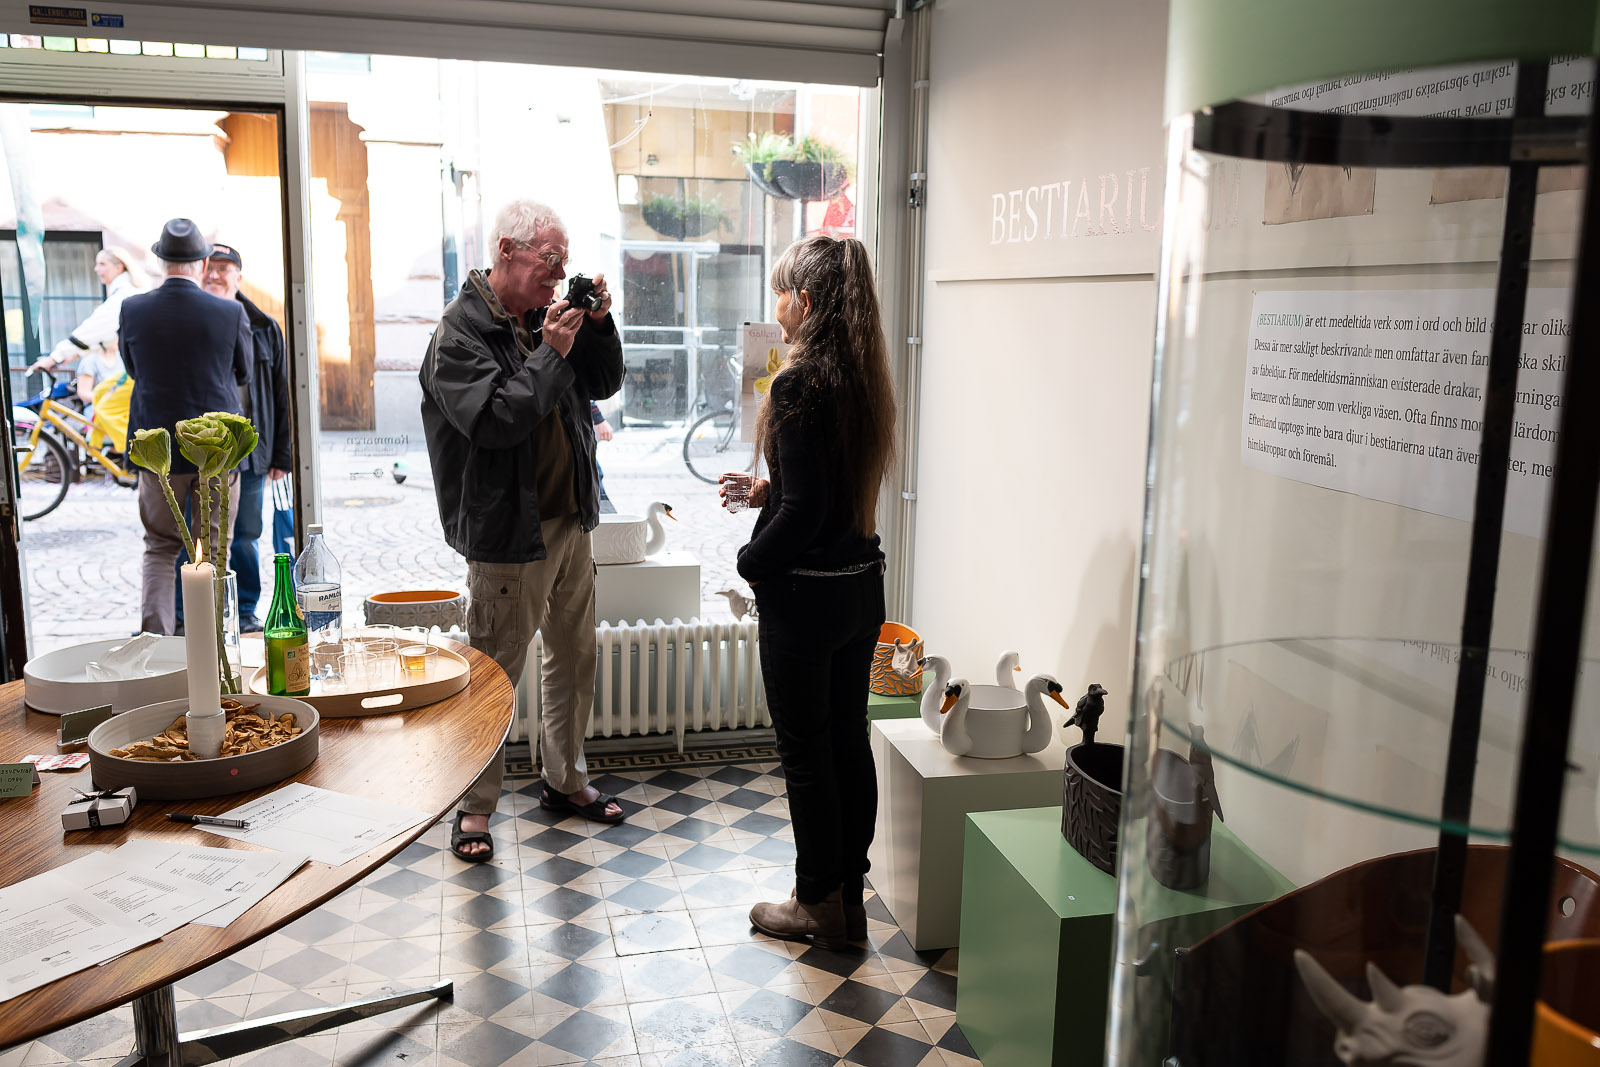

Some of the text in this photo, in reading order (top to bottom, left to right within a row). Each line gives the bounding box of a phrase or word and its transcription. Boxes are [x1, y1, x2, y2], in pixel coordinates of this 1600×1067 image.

[1257, 313, 1304, 330] (BESTIARIUM)
[1304, 314, 1314, 328] är
[1314, 316, 1328, 328] ett
[1328, 314, 1371, 329] medeltida
[1373, 315, 1392, 330] verk
[1393, 319, 1414, 331] som
[1415, 316, 1420, 331] i
[1421, 316, 1440, 332] ord
[1442, 316, 1463, 333] och
[1464, 316, 1487, 333] bild
[1254, 338, 1271, 351] Dessa
[1271, 339, 1279, 352] är
[1279, 343, 1293, 353] mer
[1293, 341, 1320, 358] sakligt
[1320, 341, 1373, 358] beskrivande
[1374, 347, 1394, 360] men
[1395, 346, 1440, 363] omfattar
[1442, 348, 1468, 365] även
[1251, 365, 1260, 376] av
[1259, 364, 1287, 380] fabeldjur.
[1288, 367, 1300, 381] För
[1301, 369, 1388, 390] medeltidsmänniskan
[1390, 376, 1441, 395] existerade
[1443, 380, 1482, 402] drakar,
[1250, 387, 1279, 404] kentaurer
[1278, 393, 1291, 406] och
[1291, 394, 1317, 410] fauner
[1317, 400, 1335, 412] som
[1337, 401, 1372, 420] verkliga
[1374, 404, 1402, 422] väsen.
[1404, 408, 1427, 425] Ofta
[1429, 410, 1458, 430] finns
[1247, 437, 1337, 468] himlakroppar och föremål.
[1248, 412, 1277, 430] Efterhand
[1277, 421, 1305, 437] upptogs
[1305, 422, 1322, 438] inte
[1323, 425, 1344, 441] bara
[1345, 429, 1364, 446] djur
[1370, 432, 1425, 456] bestiarierna
[1427, 445, 1454, 461] utan
